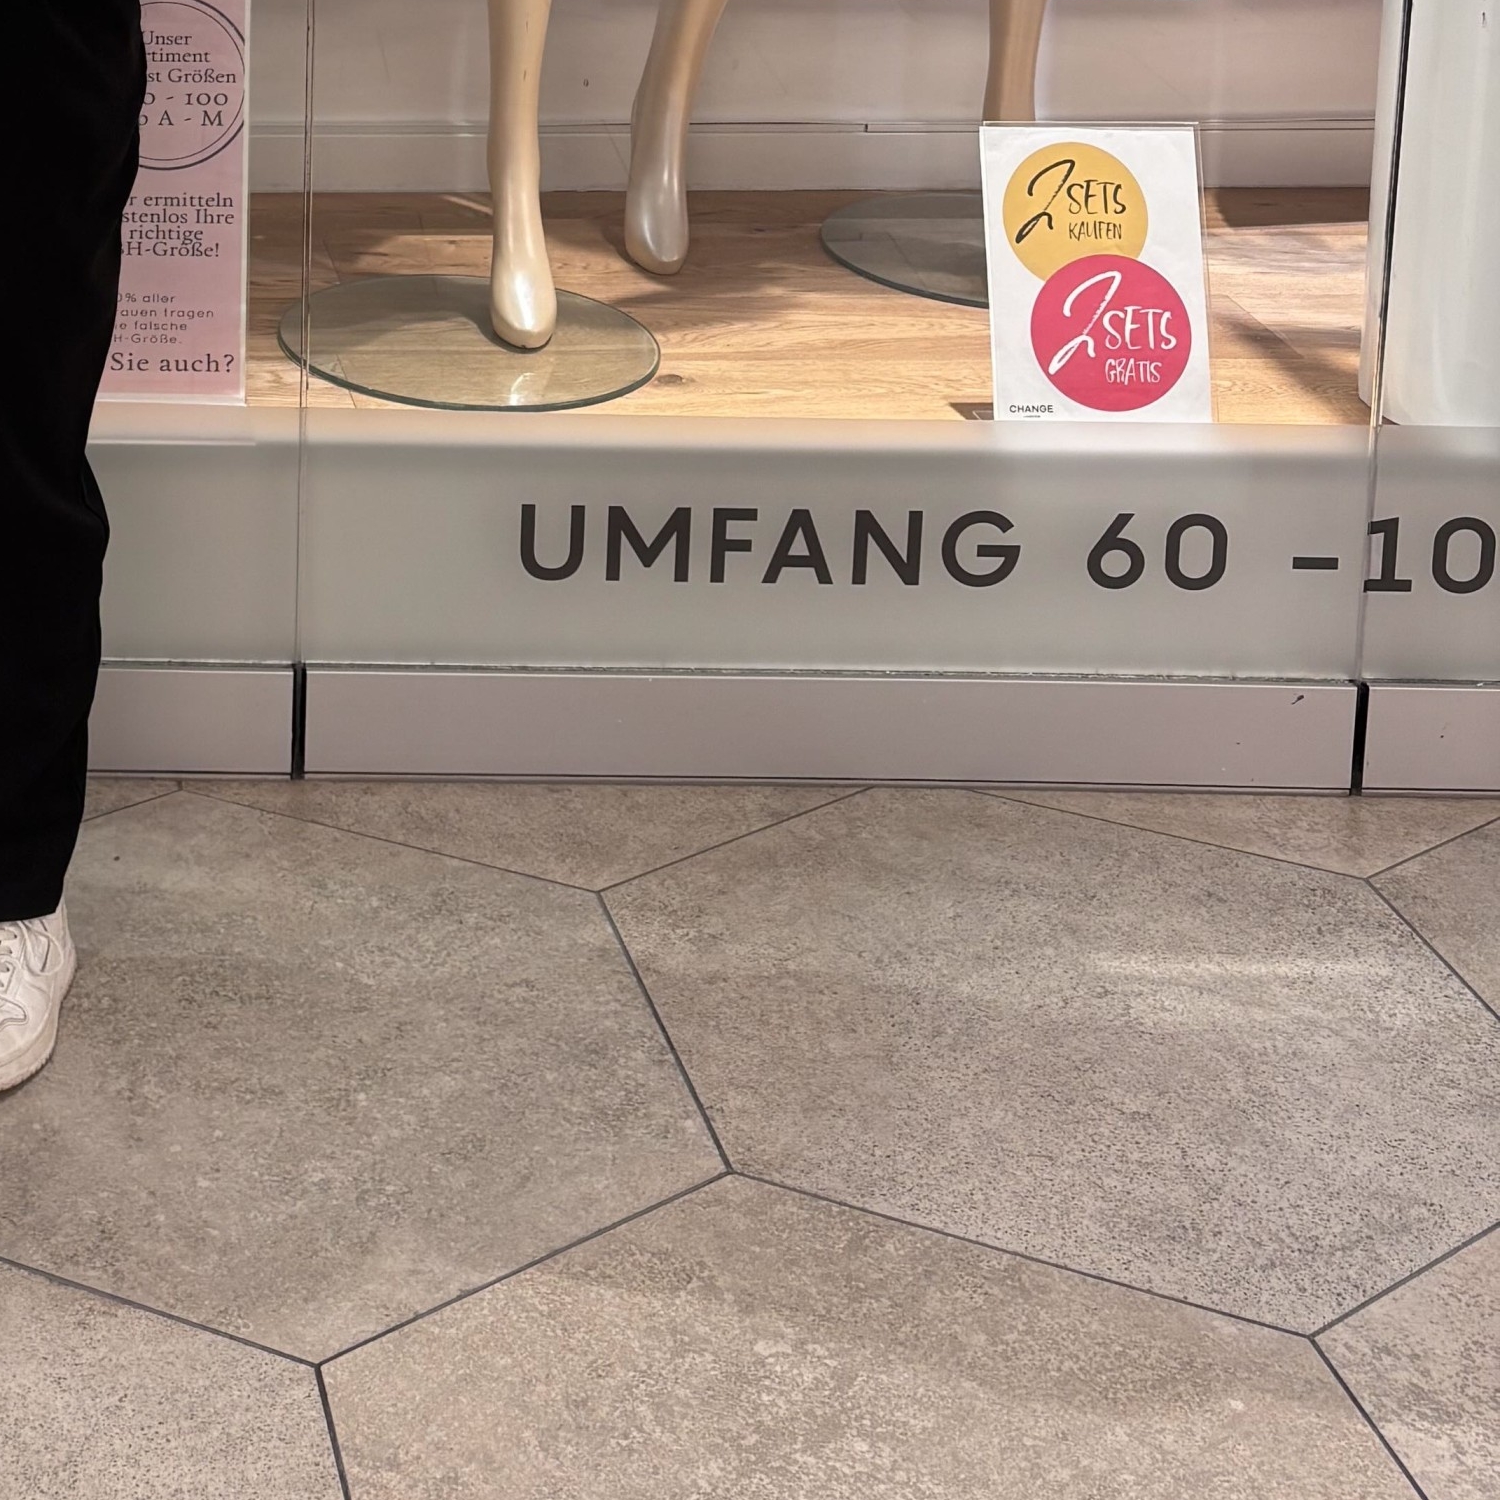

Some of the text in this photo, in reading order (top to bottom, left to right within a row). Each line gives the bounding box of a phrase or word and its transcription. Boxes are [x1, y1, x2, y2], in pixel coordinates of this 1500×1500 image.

[142, 30, 192, 46] Unser
[167, 68, 237, 84] Größen
[184, 92, 229, 106] 100
[158, 109, 175, 126] A
[200, 110, 224, 127] M
[143, 192, 234, 208] ermitteln
[1015, 158, 1127, 244] 2 SETS
[121, 208, 235, 225] stenlos Ihre
[129, 225, 204, 246] richtige
[1068, 220, 1122, 242] KAUFEN
[121, 241, 220, 258] H-Größe!
[142, 293, 177, 303] aller
[134, 321, 187, 331] falsche
[1048, 271, 1177, 376] 2 SETS
[113, 333, 183, 344] H-Größe.
[110, 352, 235, 373] Sie auch?
[1104, 357, 1162, 386] GRATIS
[1009, 404, 1054, 413] CHANGE
[518, 503, 1023, 588] UMFANG
[1085, 511, 1230, 592] 60
